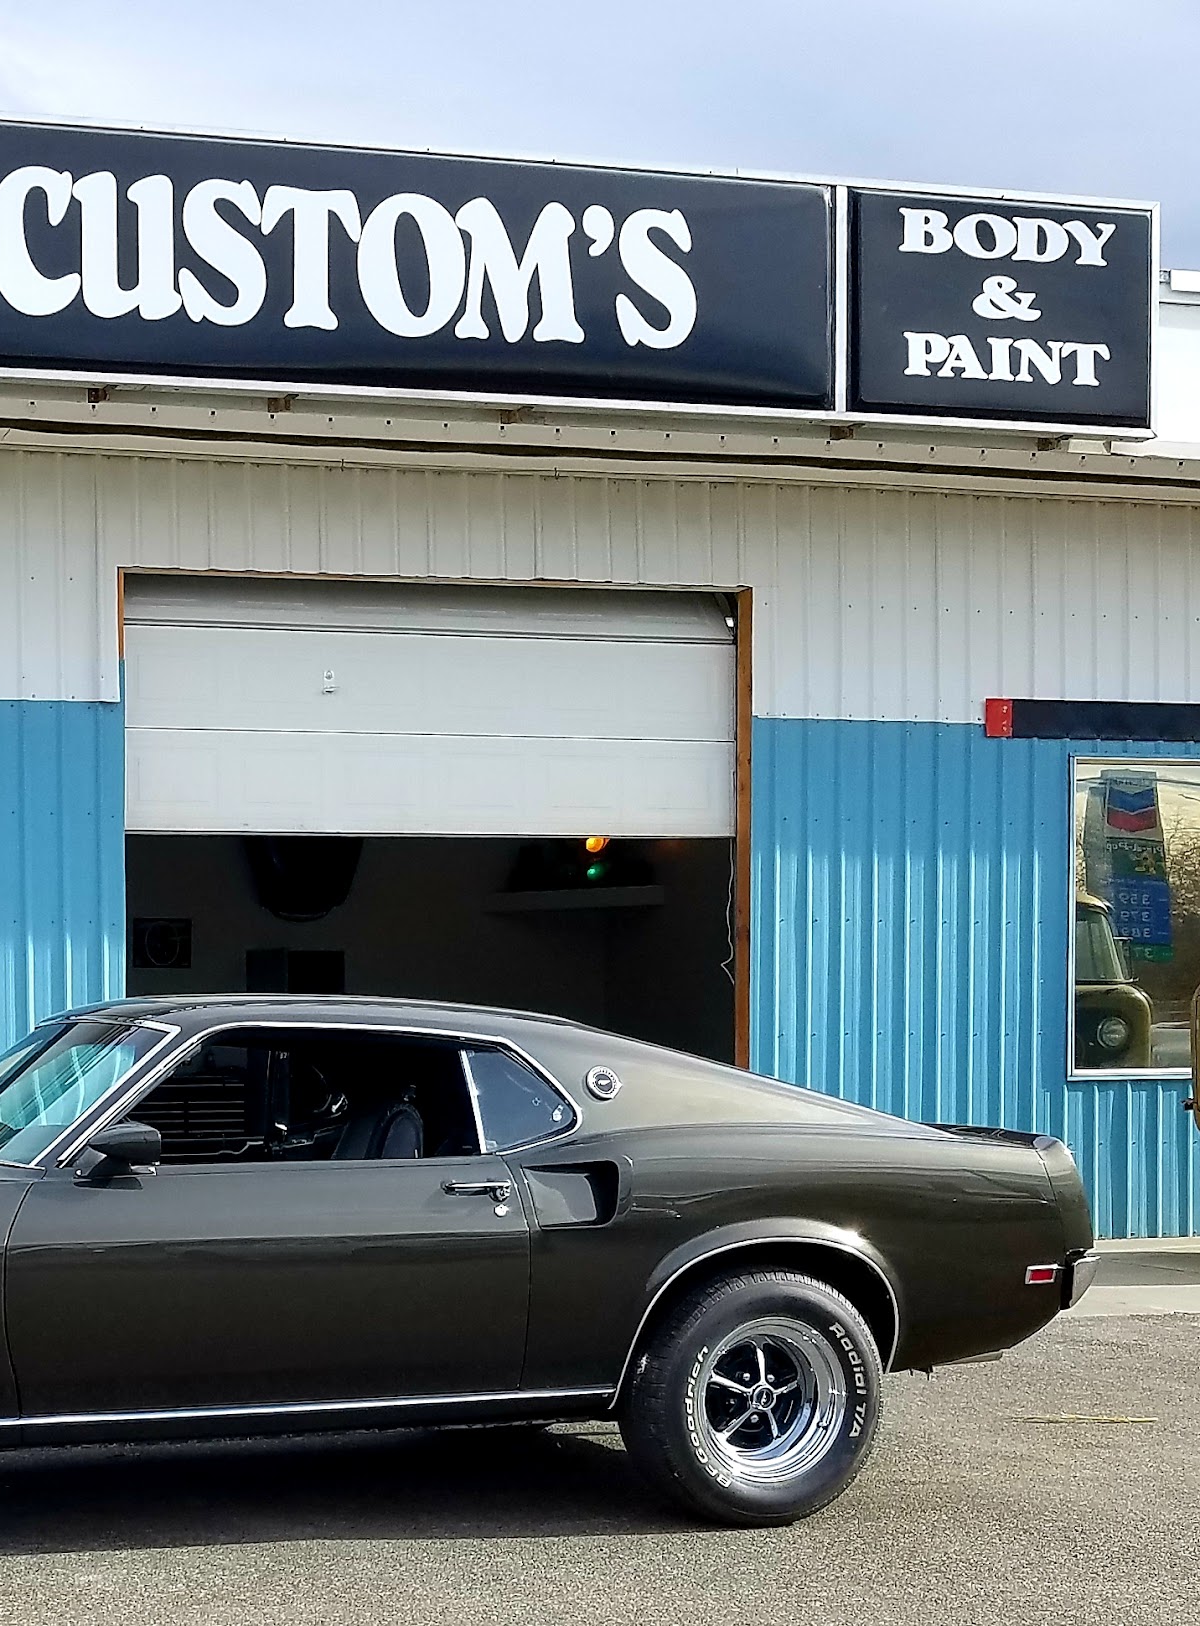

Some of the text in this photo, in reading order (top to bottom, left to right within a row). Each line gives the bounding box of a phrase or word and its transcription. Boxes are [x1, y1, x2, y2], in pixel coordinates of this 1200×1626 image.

[898, 207, 1117, 267] BODY
[971, 275, 1042, 322] &
[902, 331, 1111, 387] PAINT
[828, 1321, 868, 1438] Radial T/A
[684, 1346, 733, 1488] BFGoodrich
